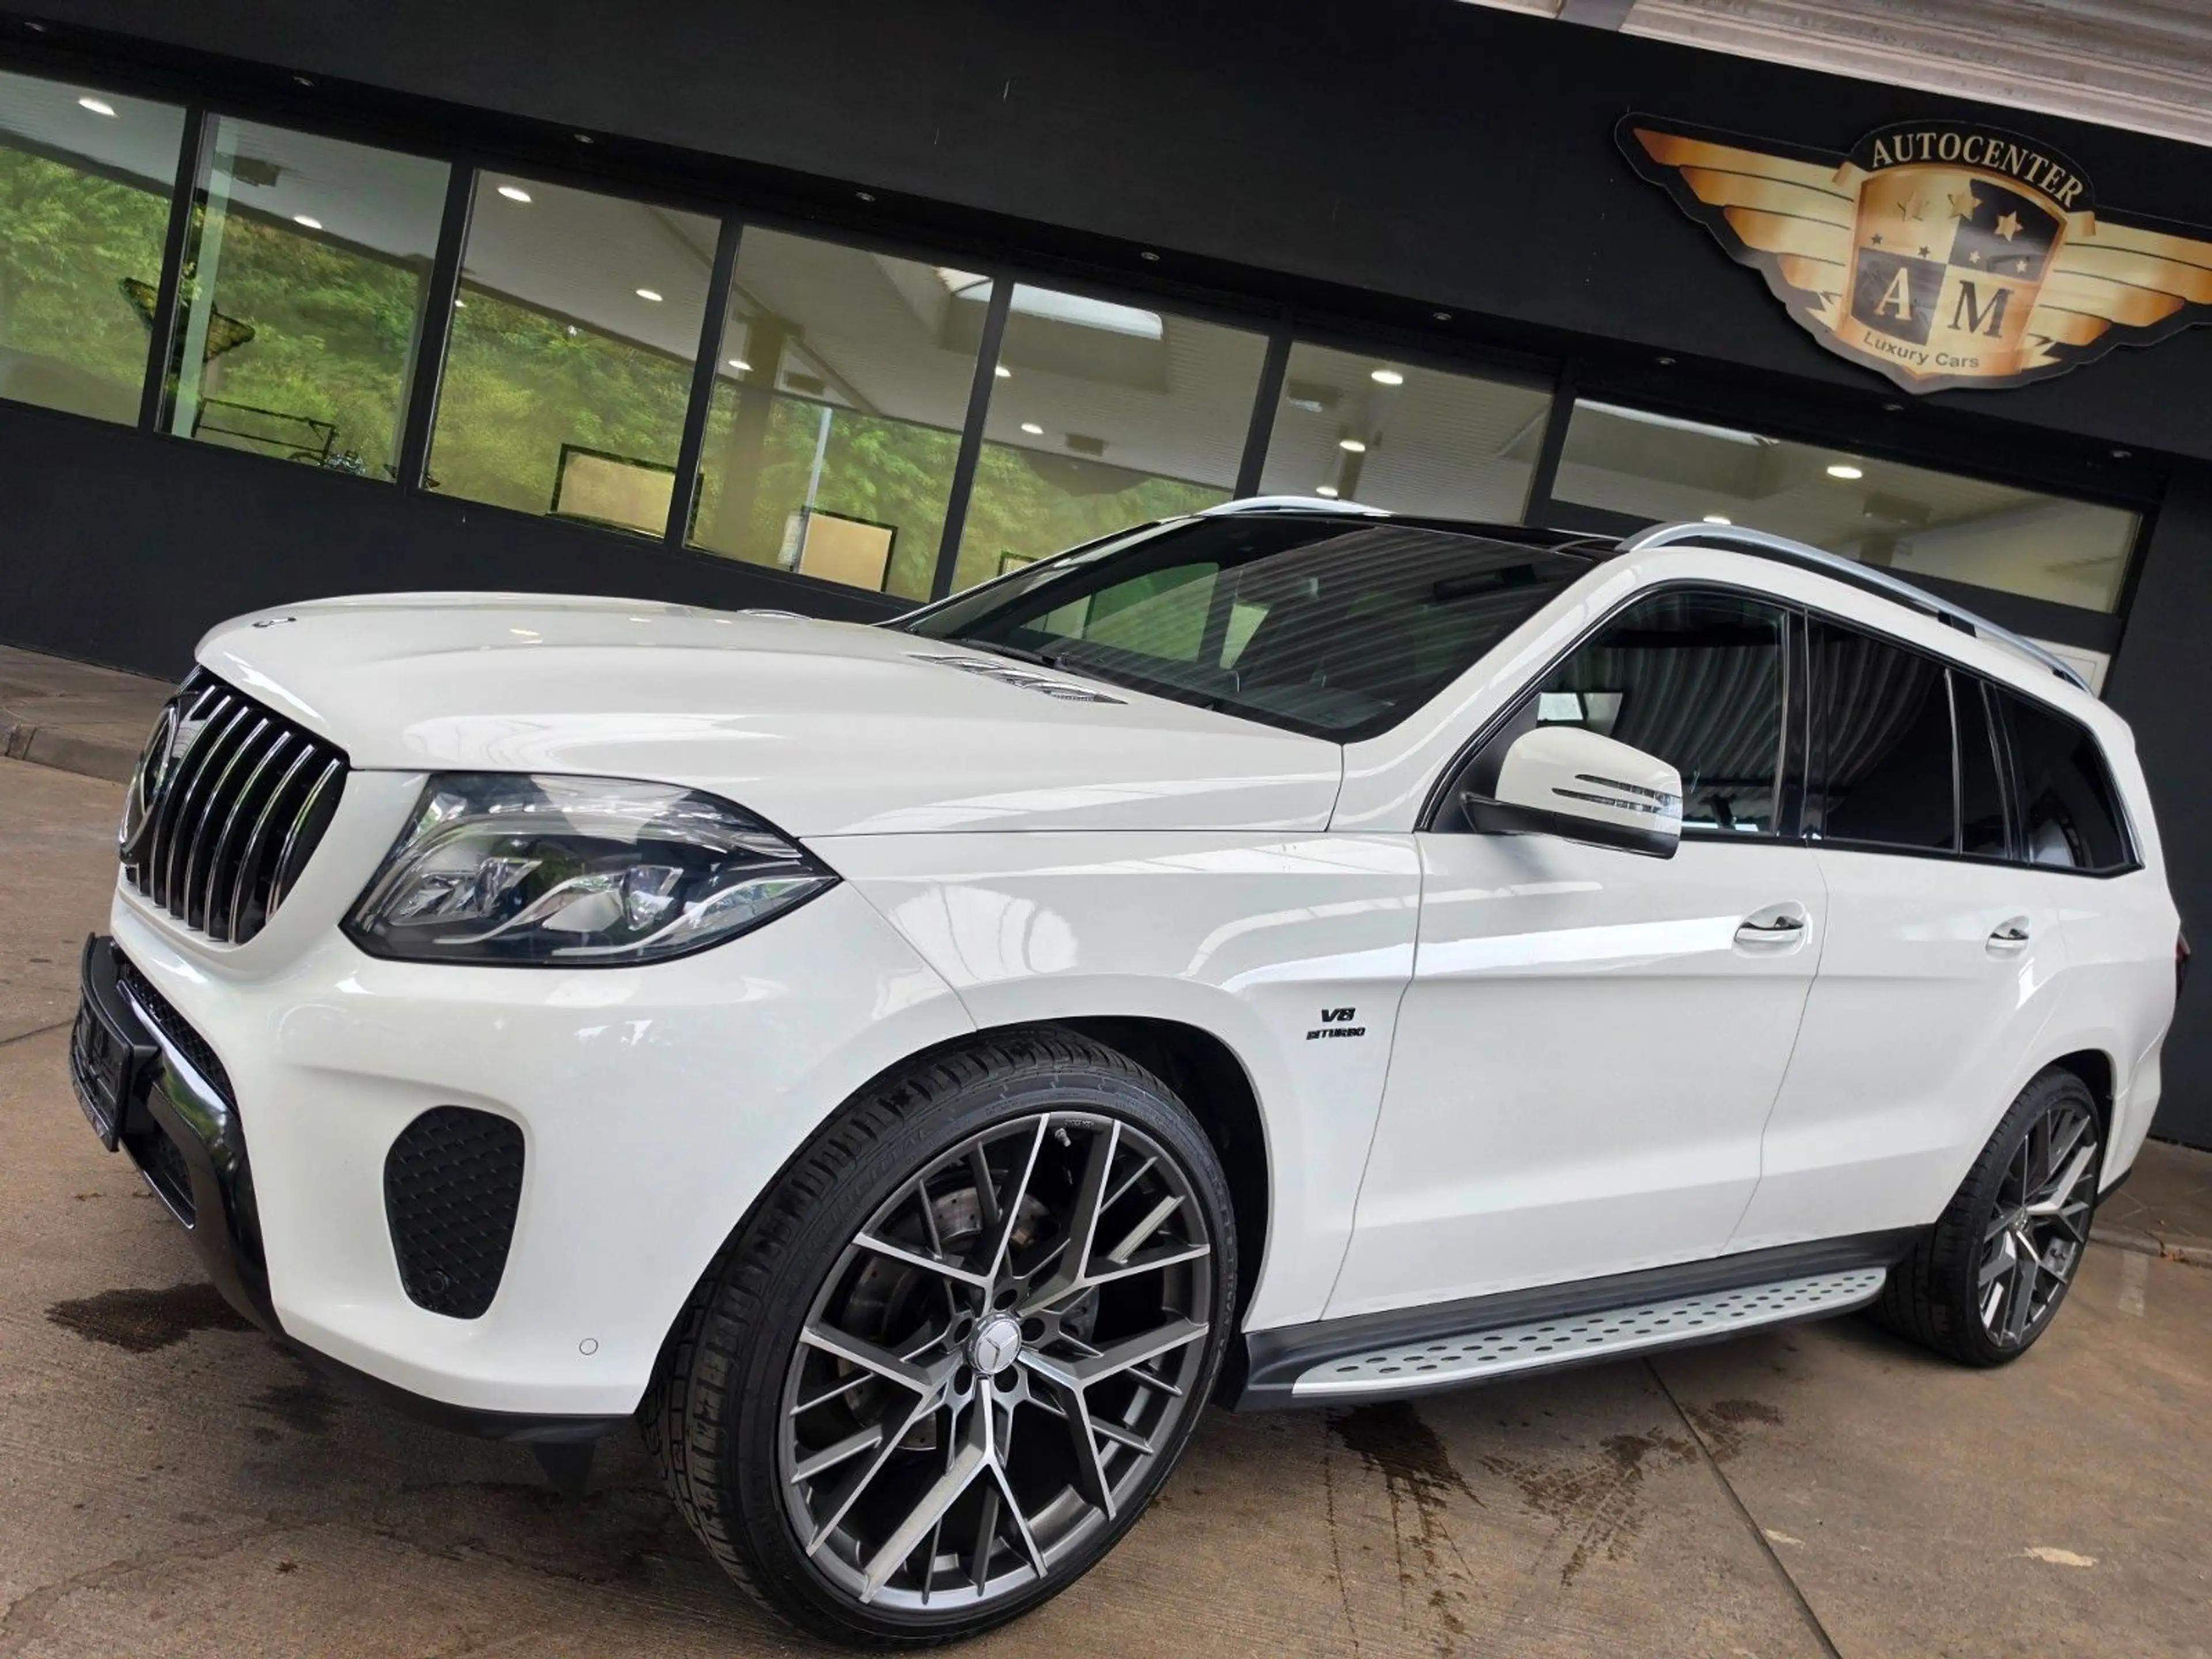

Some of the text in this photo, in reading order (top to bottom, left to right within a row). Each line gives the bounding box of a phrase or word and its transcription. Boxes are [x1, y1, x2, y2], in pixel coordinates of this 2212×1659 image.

[1872, 132, 2084, 208] AUTOCENTER
[1873, 267, 2015, 339] A M
[1862, 329, 1980, 369] Luxury Cars
[1321, 1007, 1356, 1022] V8
